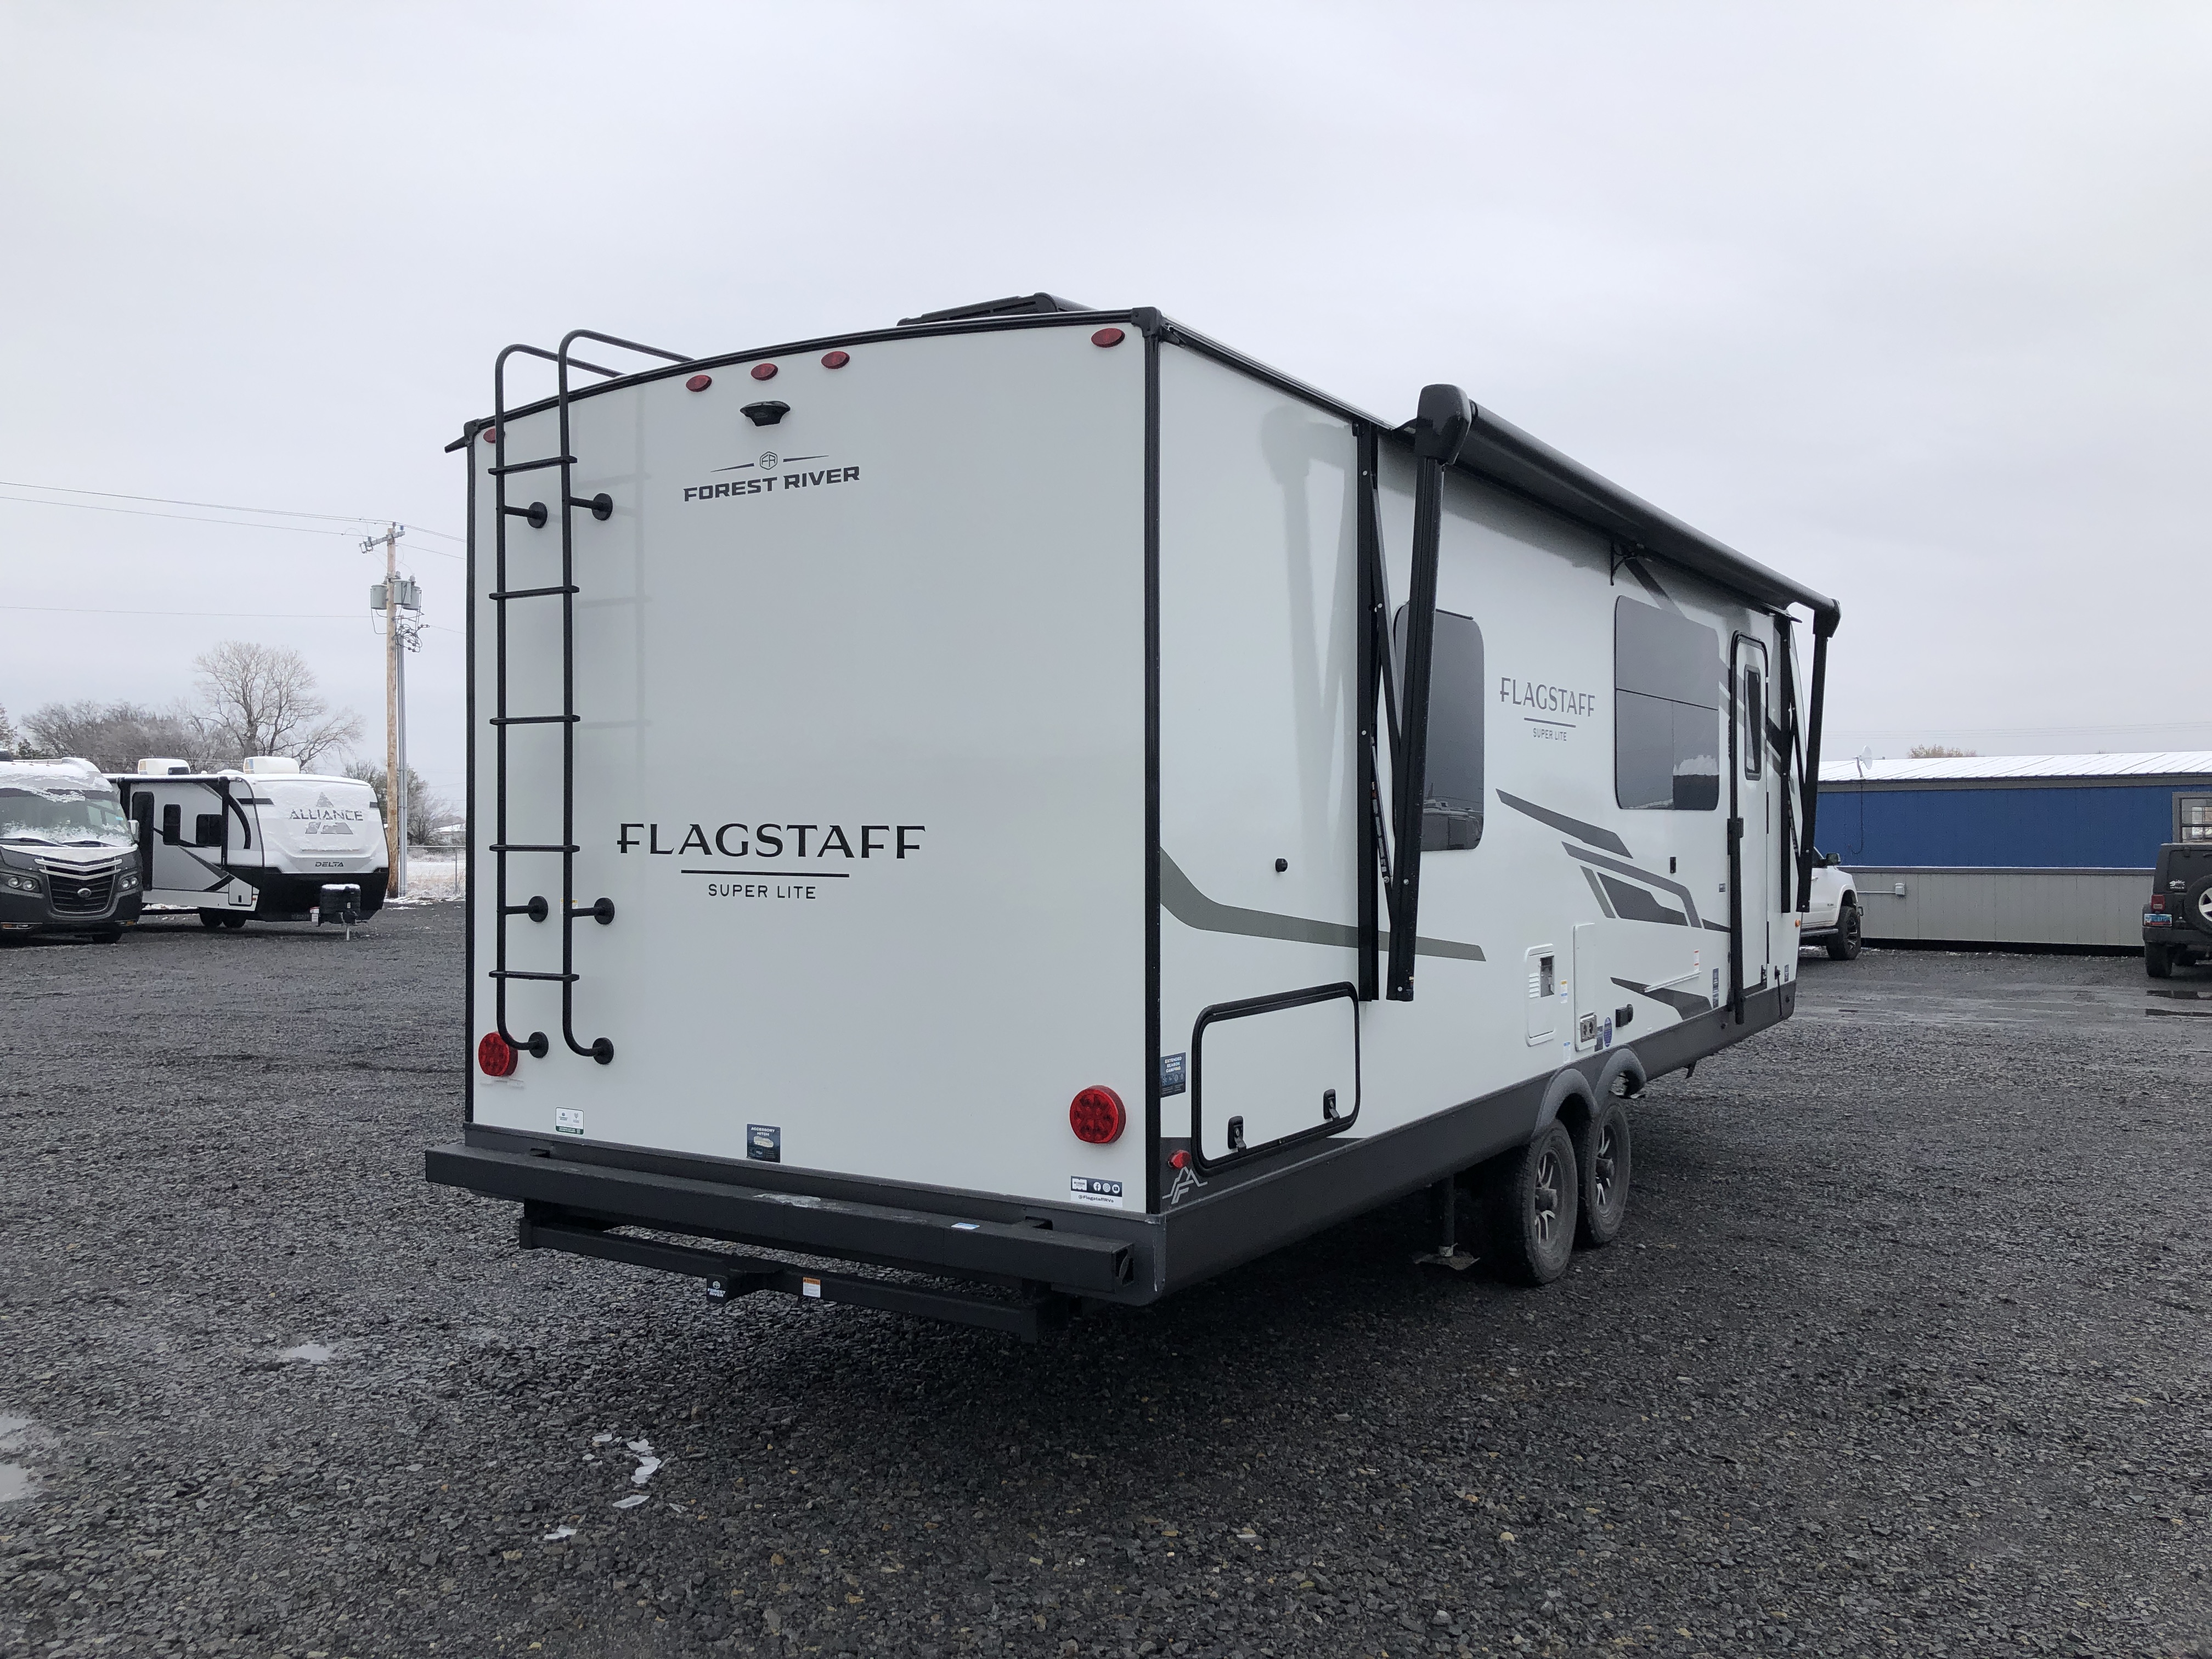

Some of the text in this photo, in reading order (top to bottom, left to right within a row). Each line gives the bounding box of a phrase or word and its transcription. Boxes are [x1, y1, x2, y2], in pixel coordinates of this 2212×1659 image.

[683, 466, 860, 502] FOREST RIVER
[1500, 677, 1595, 716] FLAGSTAFF
[1533, 727, 1567, 741] SUPER LITE
[289, 809, 363, 821] ALLIANCE
[617, 823, 926, 859] FLAGSTAFF
[708, 883, 816, 899] SUPER LITE
